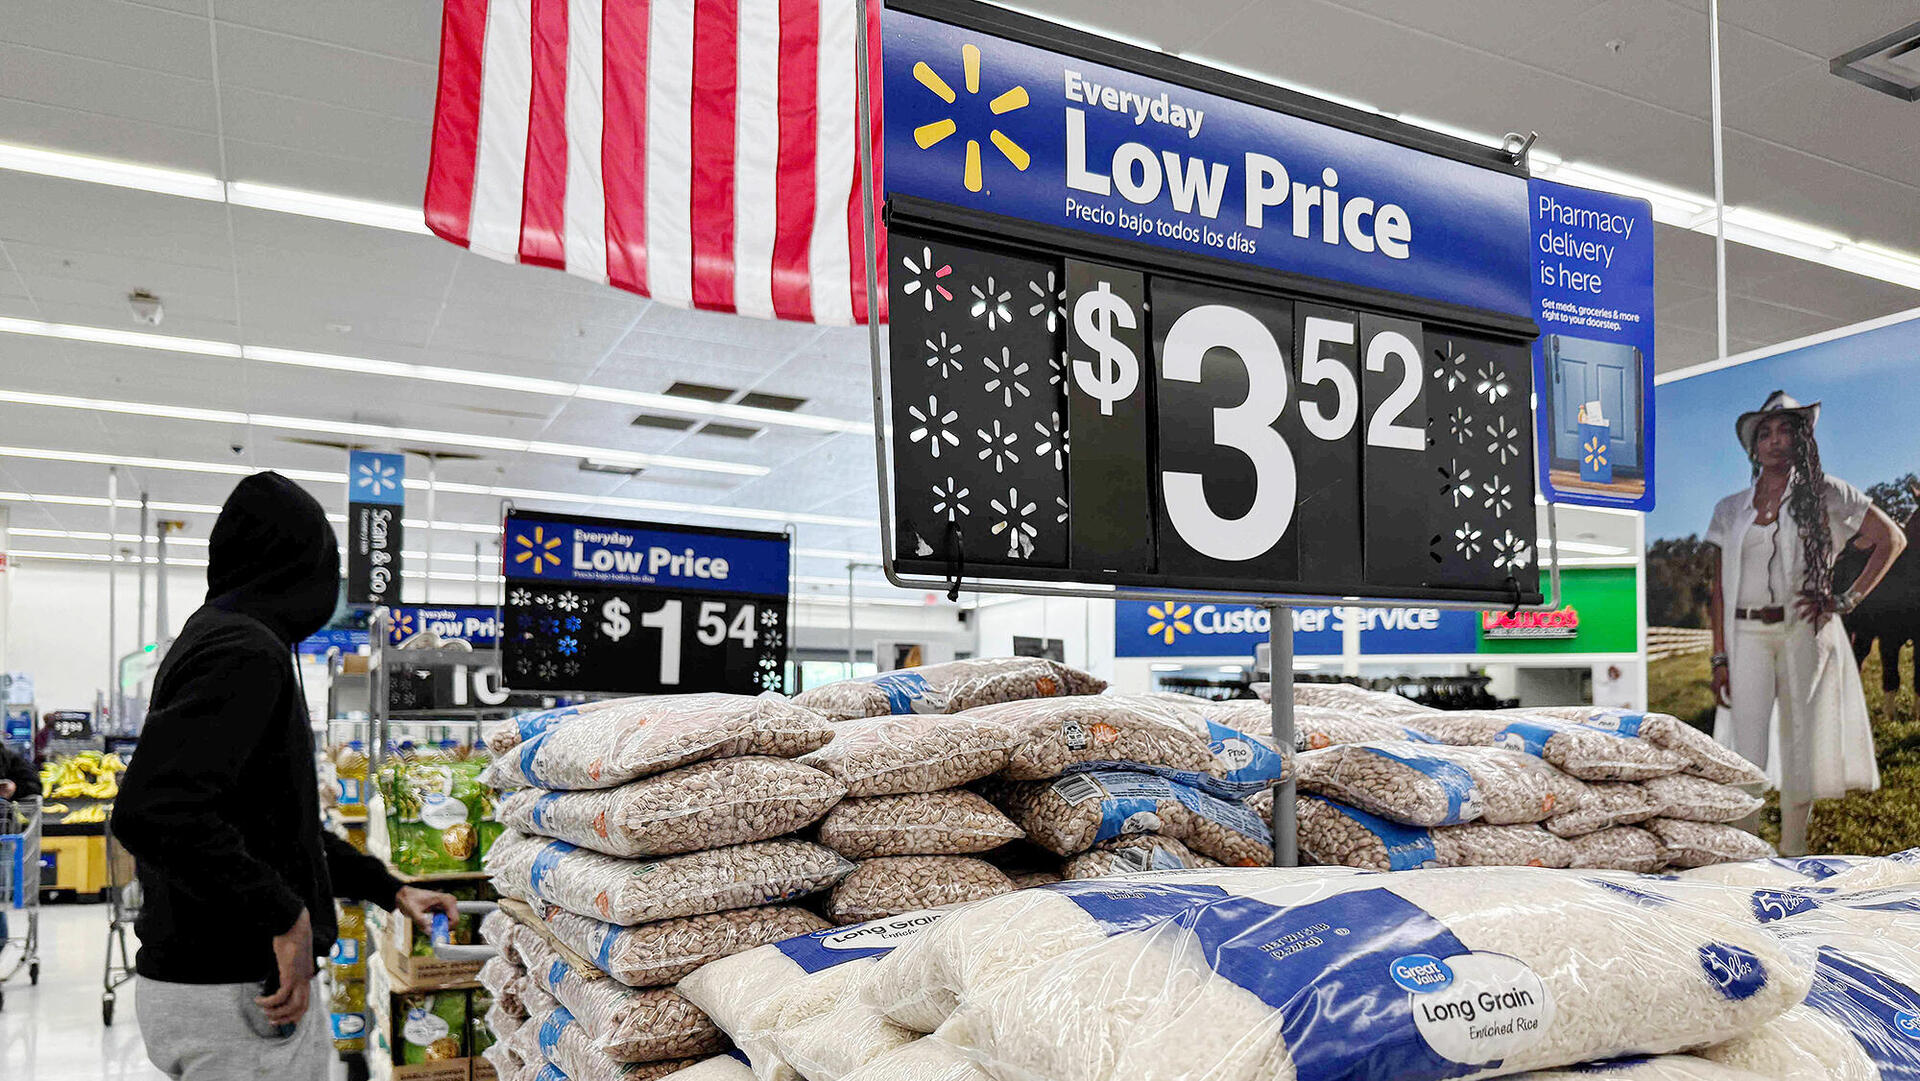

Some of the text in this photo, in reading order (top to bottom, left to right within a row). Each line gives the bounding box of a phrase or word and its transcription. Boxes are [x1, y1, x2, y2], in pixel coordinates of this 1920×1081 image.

[1064, 69, 1204, 139] Everyday
[1065, 106, 1413, 260] Low Price
[1065, 197, 1258, 255] Precio bajo todos los días
[1539, 195, 1635, 240] Pharmacy
[1539, 228, 1615, 269] delivery
[1540, 260, 1602, 294] is here
[1541, 298, 1555, 309] Get
[1578, 306, 1612, 320] groceries
[1619, 312, 1640, 323] more
[1542, 309, 1560, 322] right
[1560, 313, 1568, 323] to
[1569, 315, 1586, 325] your
[369, 508, 393, 594] Scan & Go
[573, 528, 634, 548] Everyday
[573, 541, 645, 573] Low
[649, 546, 730, 580] Price
[418, 616, 504, 638] Low Pric
[601, 596, 631, 642] $
[832, 925, 887, 943] Long
[1396, 961, 1442, 979] Great
[1412, 973, 1447, 986] Value
[1422, 987, 1535, 1023] Long Grain
[1469, 1016, 1539, 1040] Enriched Rice
